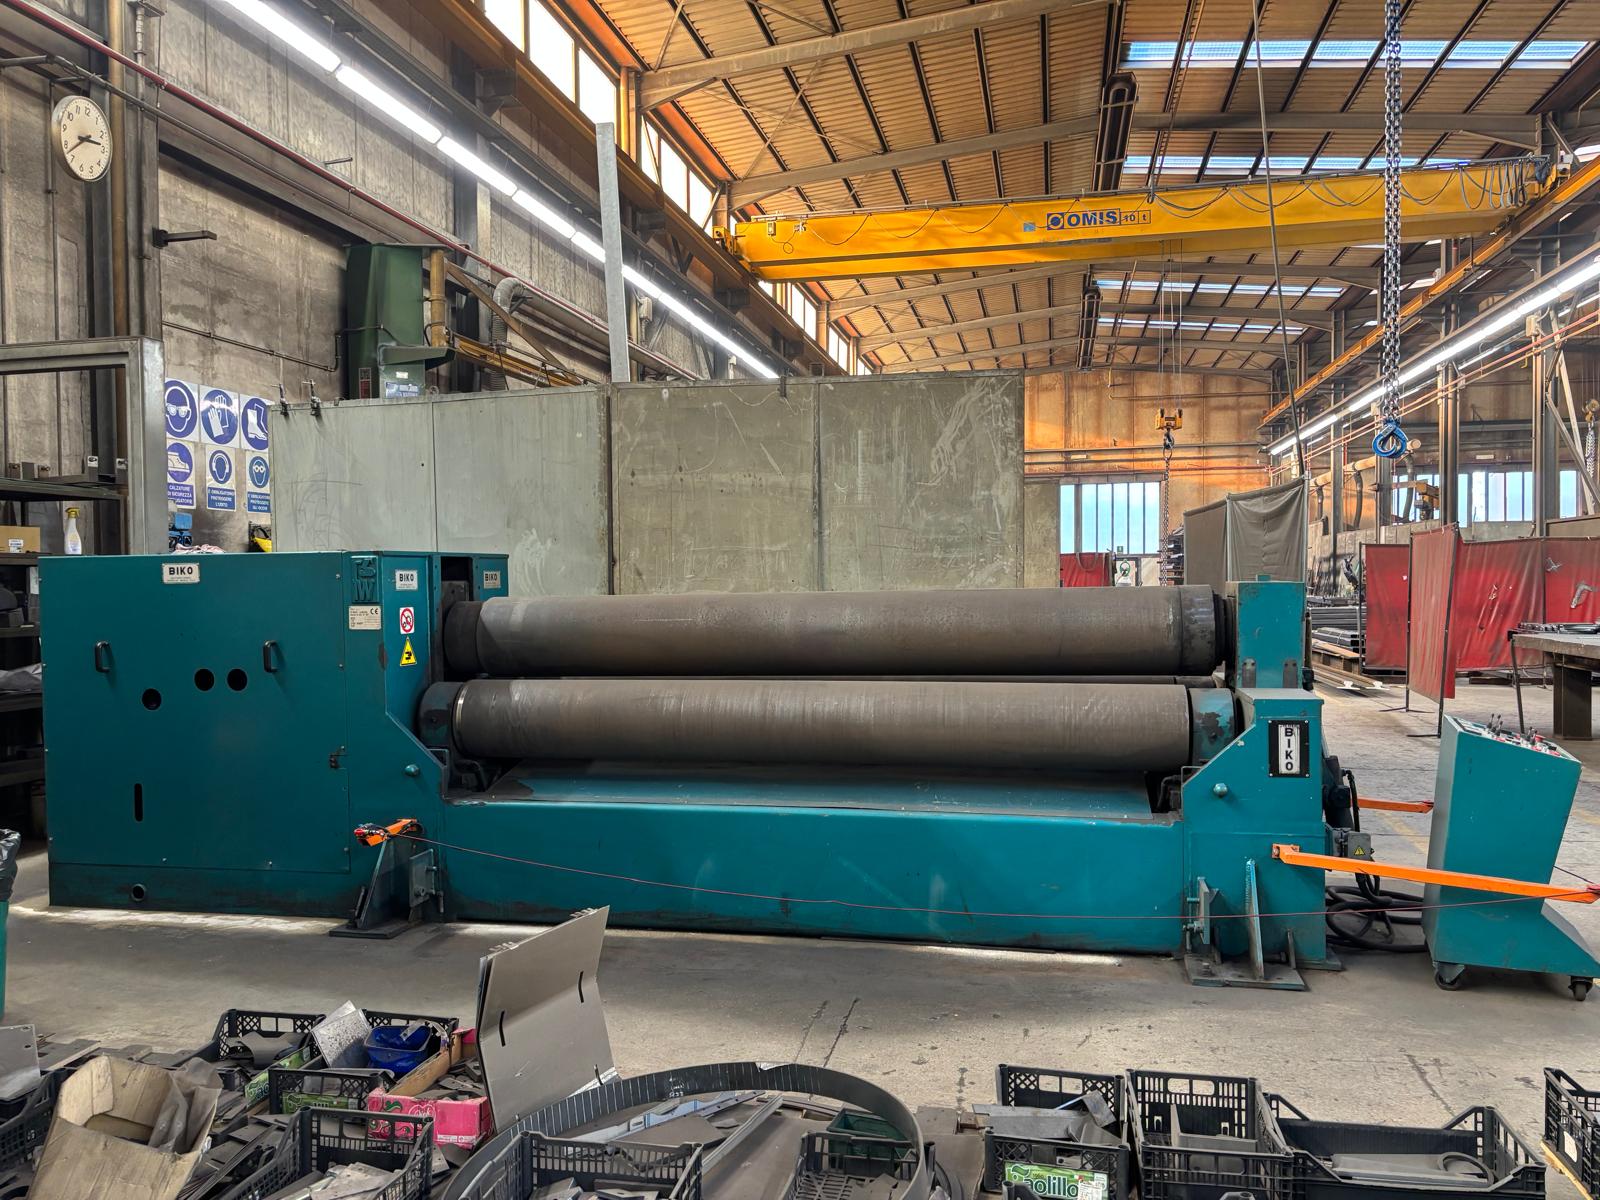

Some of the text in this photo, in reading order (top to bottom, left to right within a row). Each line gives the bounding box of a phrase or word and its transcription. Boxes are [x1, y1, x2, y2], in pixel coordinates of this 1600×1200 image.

[75, 105, 80, 114] 11
[84, 106, 90, 117] 12
[67, 112, 74, 121] 10
[62, 124, 67, 132] 9
[100, 130, 104, 139] 2
[64, 140, 68, 149] 8
[101, 146, 105, 154] 3
[70, 154, 75, 163] 7
[79, 164, 84, 172] 6
[1067, 211, 1117, 227] OMIS
[168, 566, 193, 575] BIKO
[400, 573, 414, 582] BIKO
[485, 573, 497, 582] BIKO
[370, 607, 378, 615] CE
[1284, 727, 1294, 771] BIKO
